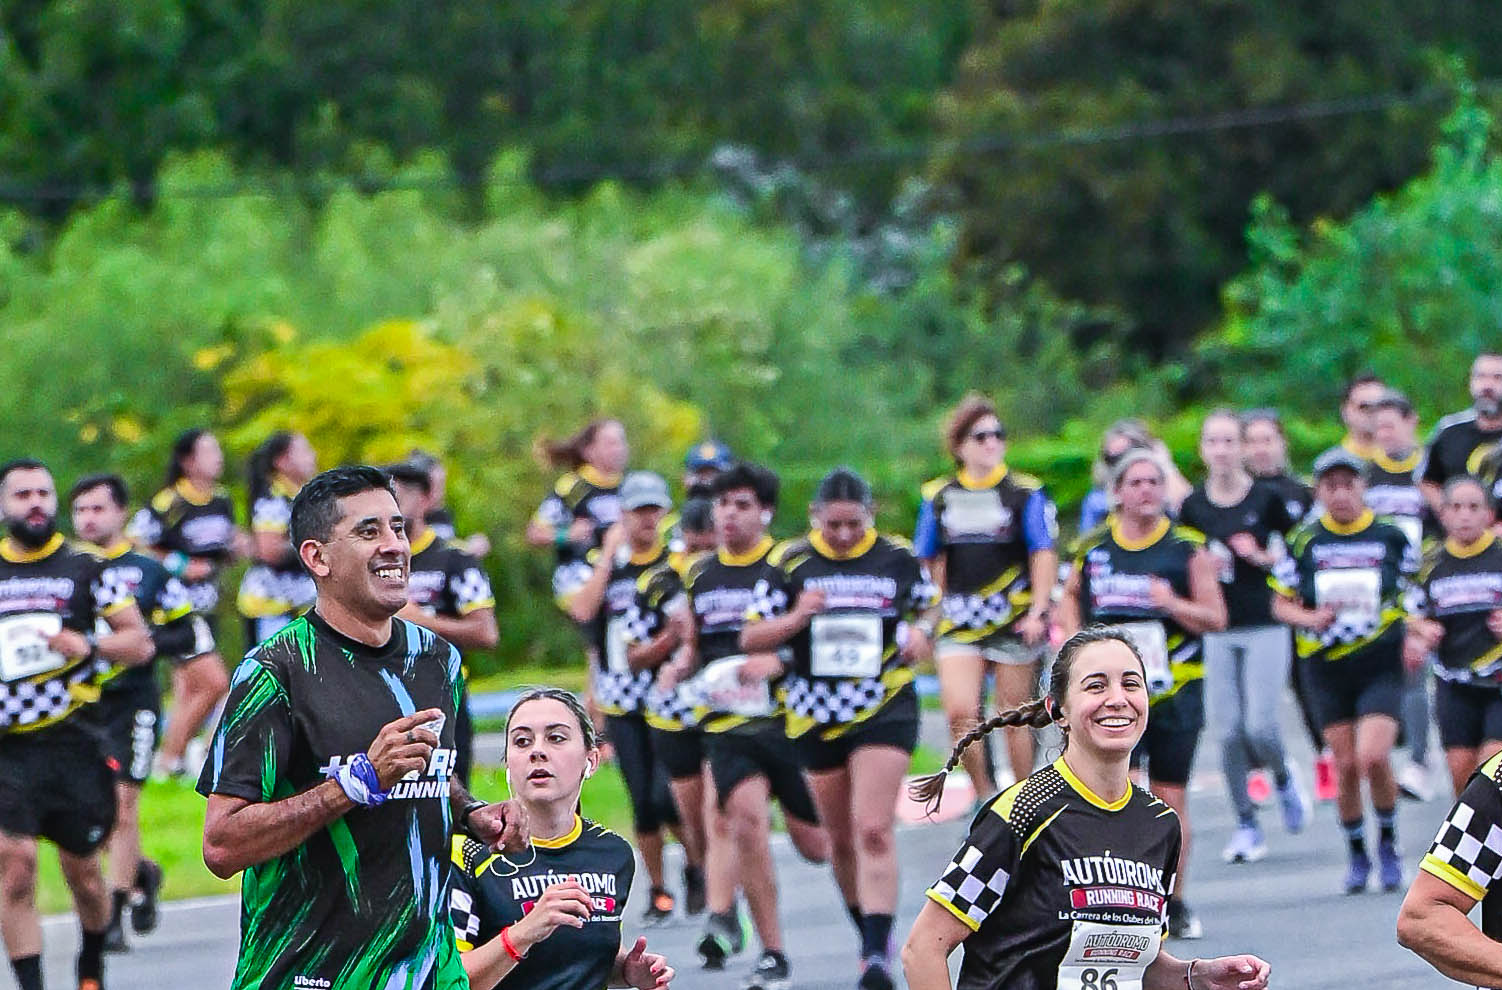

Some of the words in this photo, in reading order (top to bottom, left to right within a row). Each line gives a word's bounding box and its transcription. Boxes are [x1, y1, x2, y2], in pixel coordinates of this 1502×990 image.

[1085, 889, 1135, 906] RUNNING
[1136, 891, 1160, 912] RACE
[1058, 910, 1069, 920] La
[1070, 911, 1101, 920] Carrera
[1102, 912, 1112, 922] de
[1084, 930, 1150, 952] AUTÓDROMO
